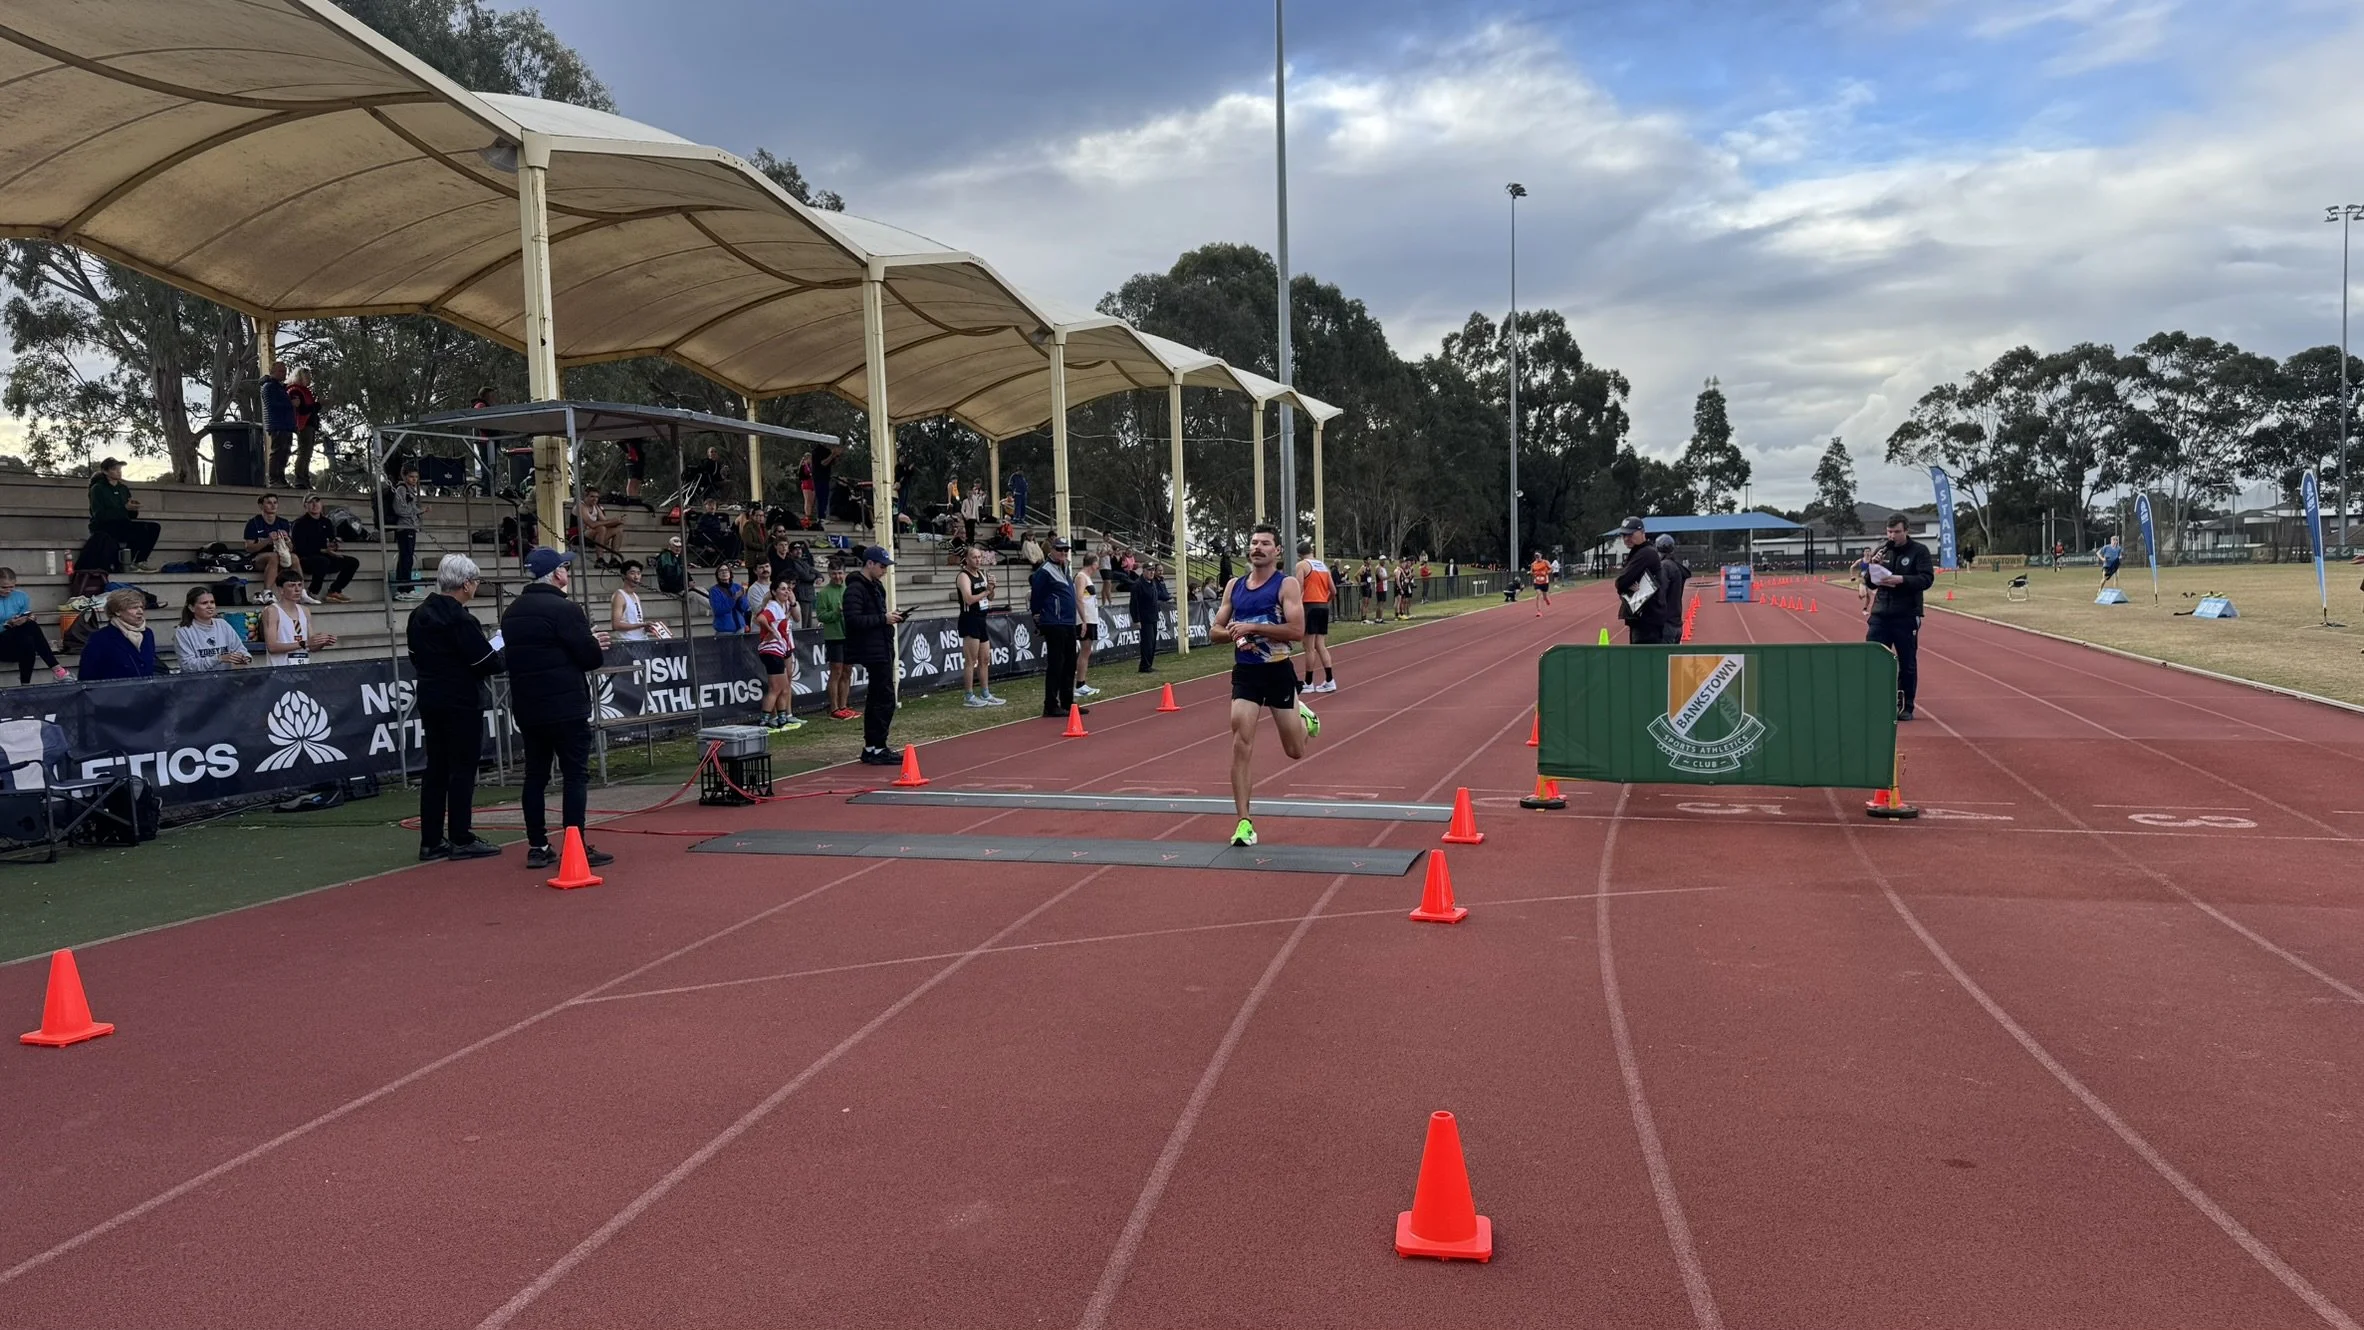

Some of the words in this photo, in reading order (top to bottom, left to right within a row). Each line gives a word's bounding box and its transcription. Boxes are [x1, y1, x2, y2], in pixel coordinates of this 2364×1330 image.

[1939, 489, 1953, 559] START
[1978, 556, 2023, 565] BANKTOWN
[1112, 613, 1131, 630] NSW
[1169, 609, 1178, 623] NS
[1117, 630, 1141, 647] ATHLE
[1174, 625, 1207, 640] ALETICS
[943, 646, 1010, 673] ATHICS
[632, 655, 688, 685] NSW
[360, 679, 418, 716] NS
[638, 678, 763, 716] ATHLETICS
[1676, 659, 1737, 729] BANKSTOWN
[1663, 733, 1697, 754] SPORTS
[1699, 734, 1749, 755] ATHLETICS
[1692, 760, 1718, 769] CLUB
[2127, 813, 2258, 828] 3
